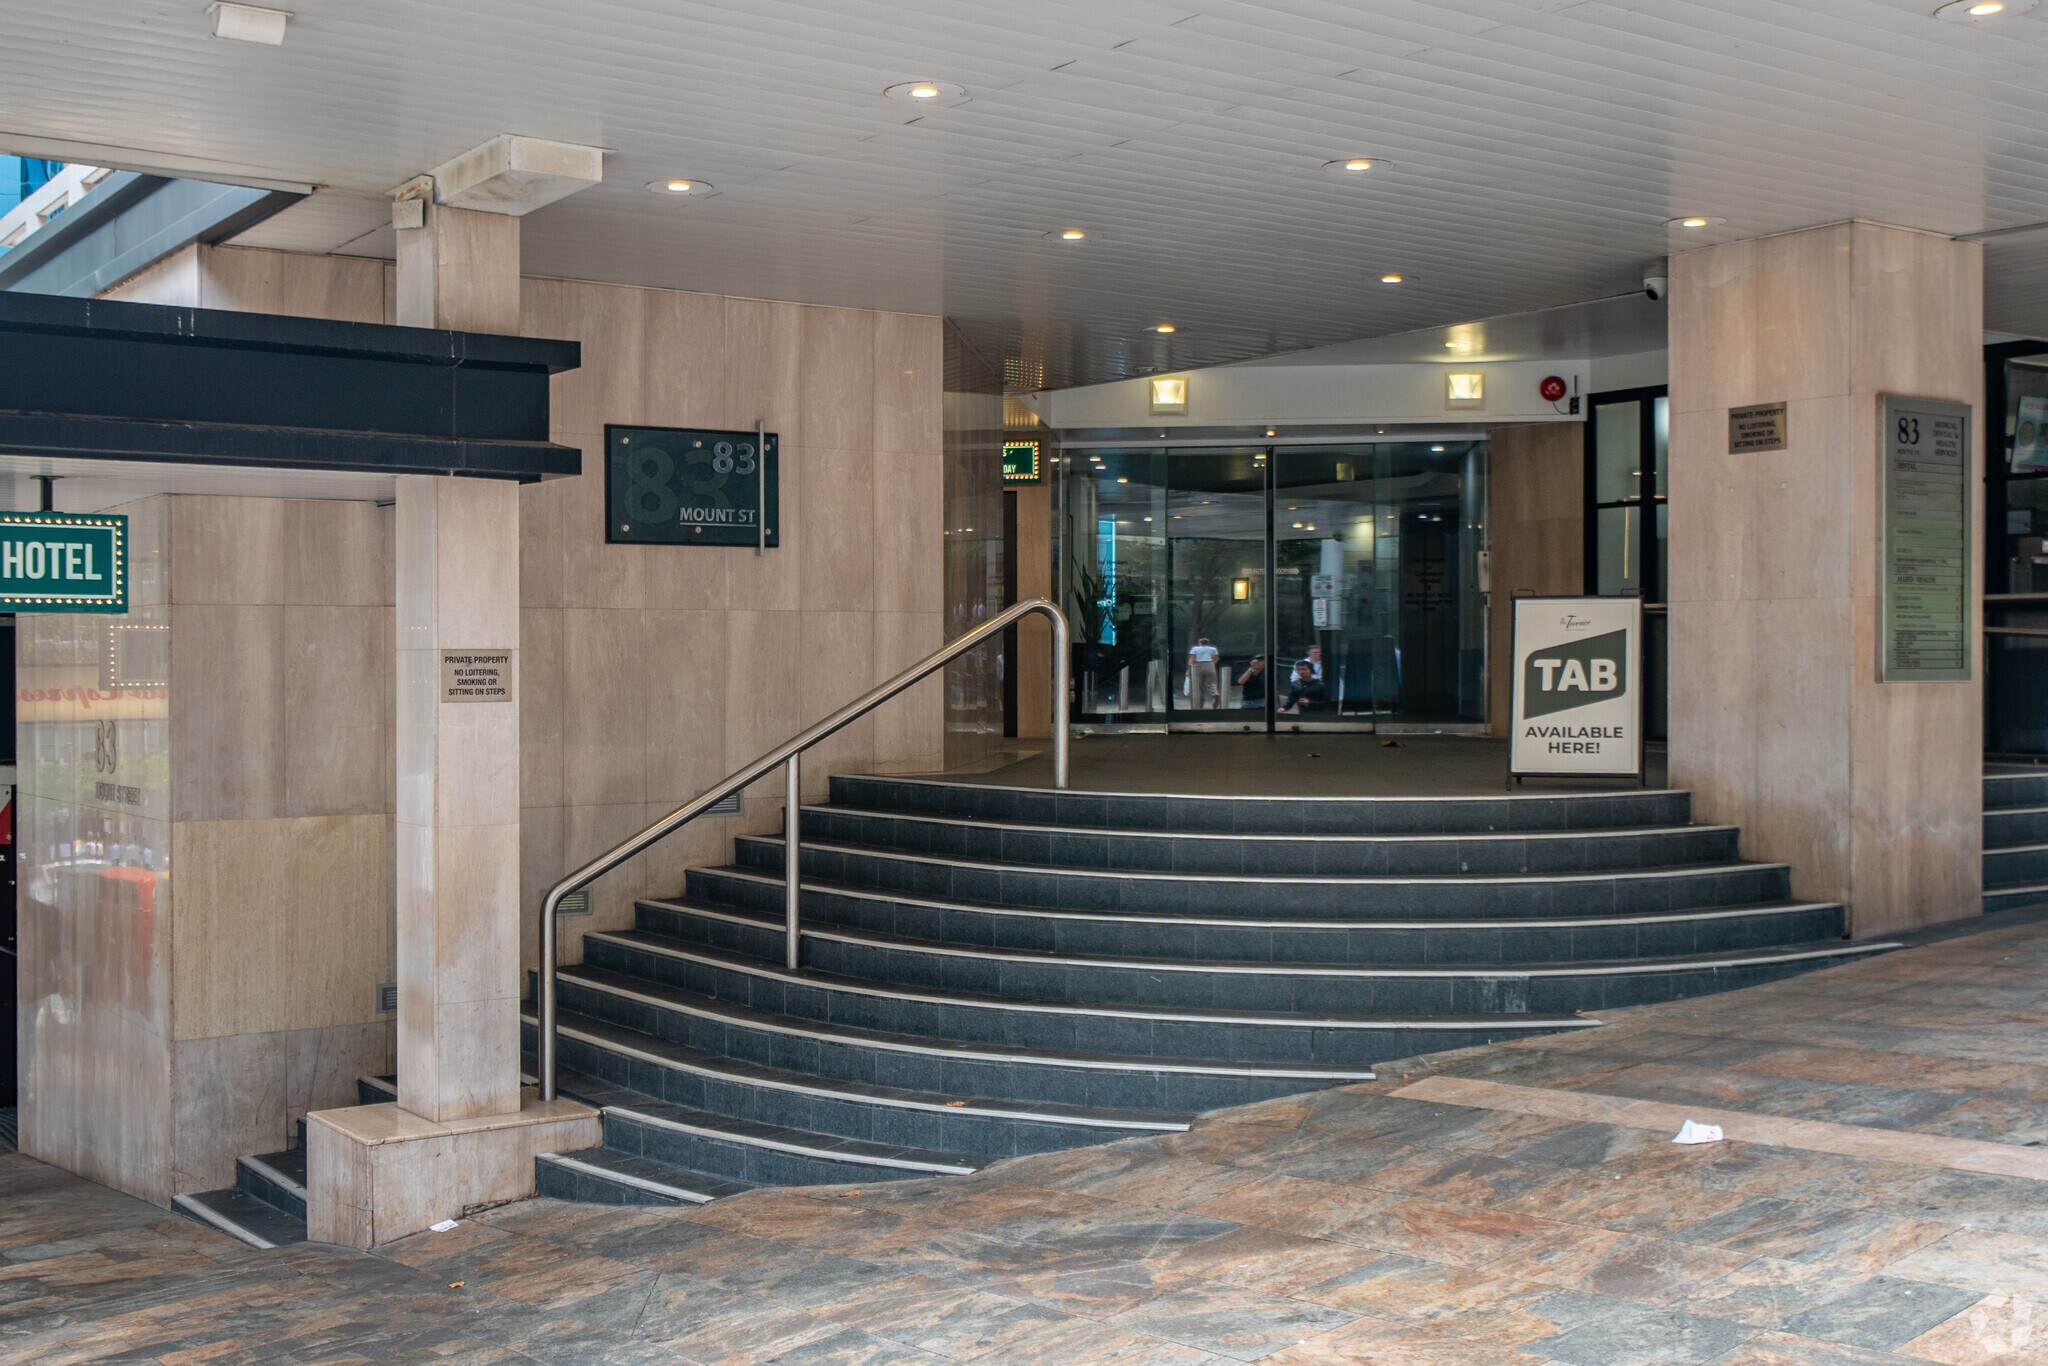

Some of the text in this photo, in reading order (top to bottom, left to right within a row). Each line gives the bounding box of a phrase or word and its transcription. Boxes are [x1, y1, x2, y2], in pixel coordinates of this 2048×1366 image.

[1898, 417, 1919, 445] 83
[712, 441, 756, 475] 83
[680, 507, 756, 523] MOUNT ST
[3, 541, 102, 580] HOTEL
[444, 655, 509, 664] PRIVATE PROPERTY
[465, 668, 500, 677] LOITERING,
[1533, 659, 1618, 692] TAB
[456, 678, 498, 686] SMOKING OR
[448, 687, 506, 696] SITTING ON STEPS
[1525, 726, 1624, 739] AVAILABLE
[95, 719, 117, 775] 83
[1548, 742, 1600, 754] HERE!
[95, 781, 141, 807] MOUNT STREET
